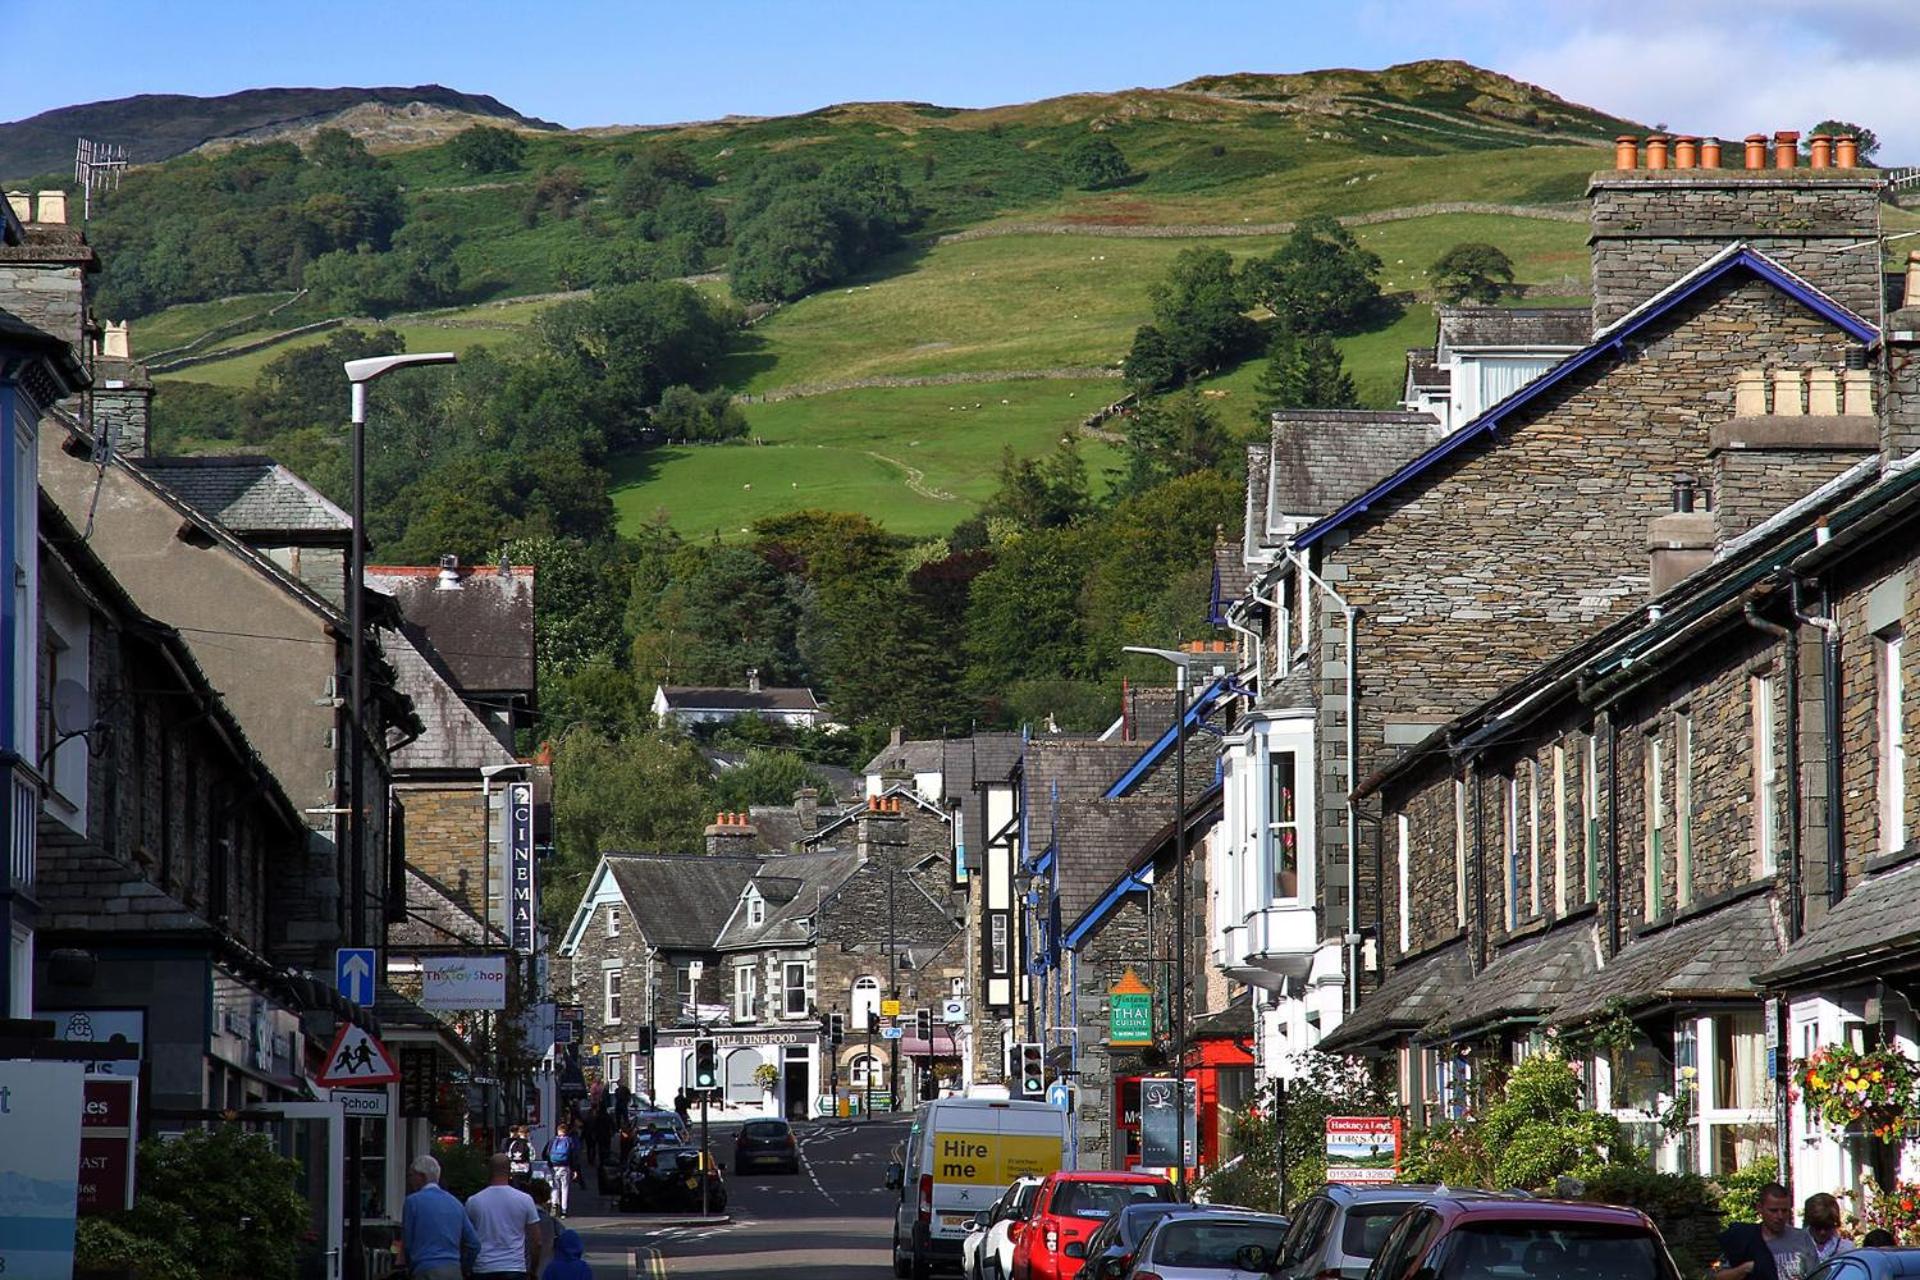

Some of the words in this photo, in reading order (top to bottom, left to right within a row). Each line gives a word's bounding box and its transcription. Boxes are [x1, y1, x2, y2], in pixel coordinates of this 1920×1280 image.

[514, 808, 530, 920] CINEMA
[474, 970, 504, 982] Shop
[1113, 1008, 1148, 1019] THAI
[742, 1033, 767, 1045] FINE
[768, 1033, 797, 1044] FOOD
[0, 1086, 11, 1114] t
[341, 1096, 380, 1110] School
[944, 1140, 988, 1158] Hire
[943, 1164, 976, 1177] me
